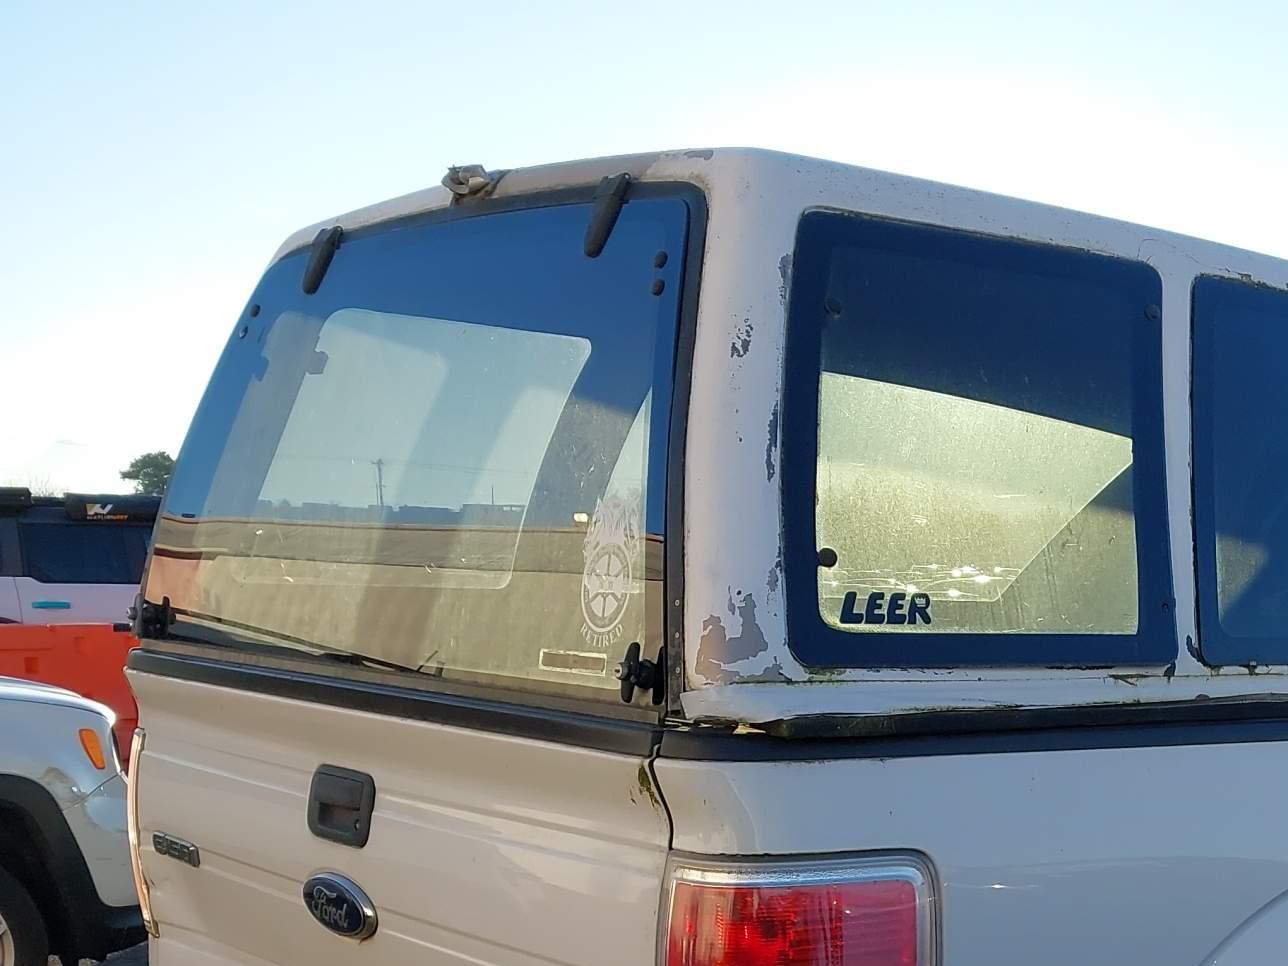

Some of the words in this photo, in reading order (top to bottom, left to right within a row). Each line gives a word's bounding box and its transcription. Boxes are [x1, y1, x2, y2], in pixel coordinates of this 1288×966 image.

[840, 591, 932, 625] LEER
[580, 623, 624, 647] RETIRED
[311, 885, 350, 929] Ford
